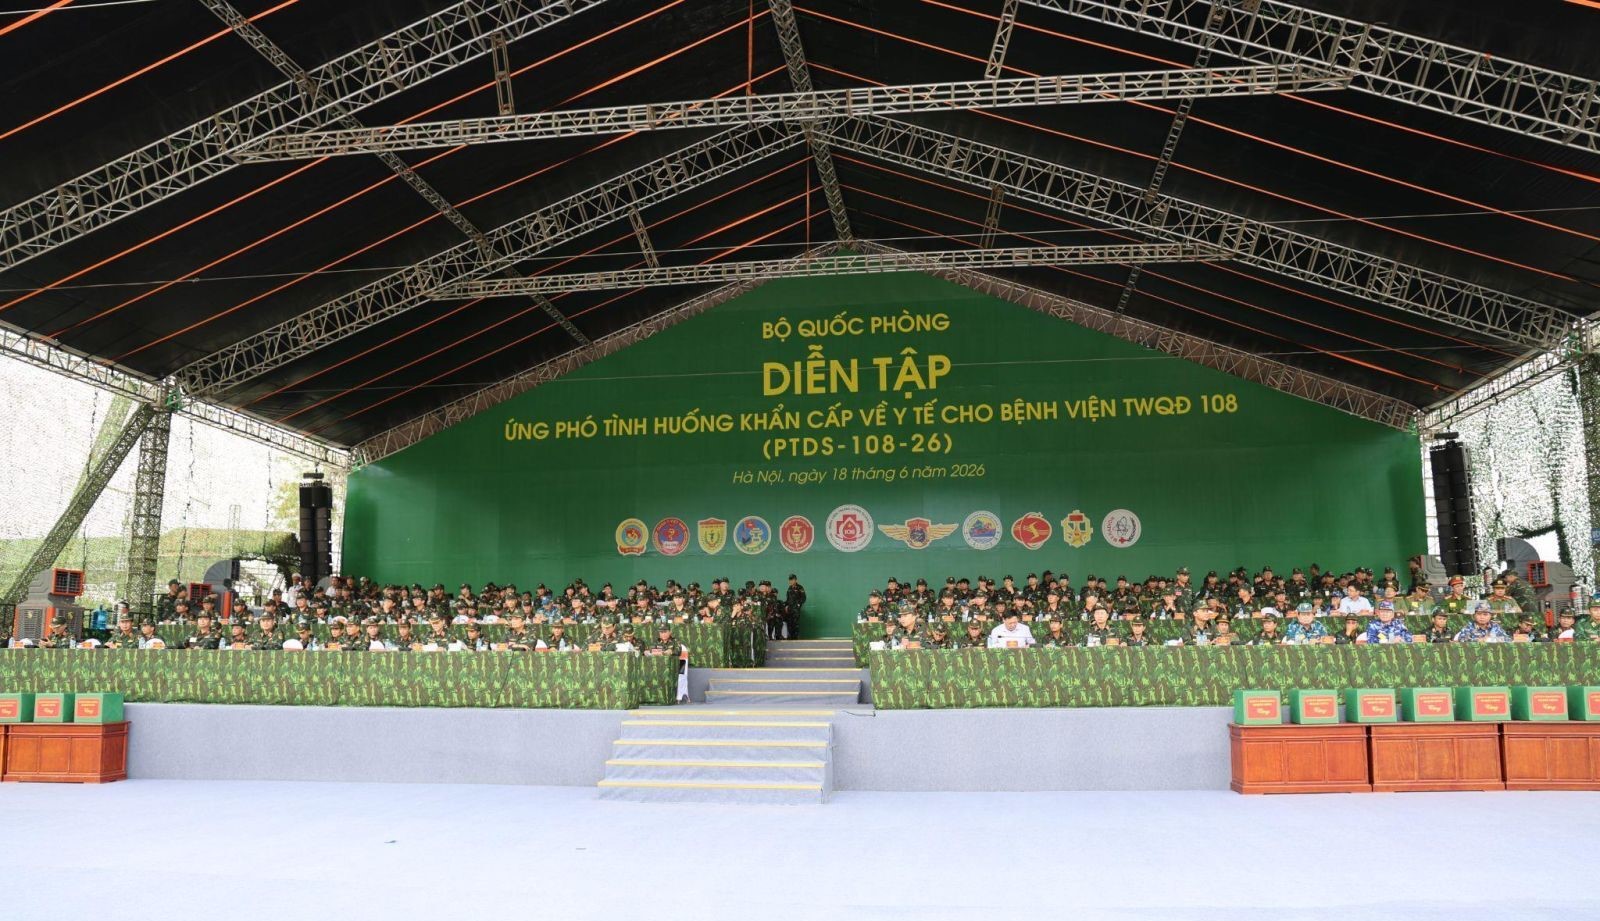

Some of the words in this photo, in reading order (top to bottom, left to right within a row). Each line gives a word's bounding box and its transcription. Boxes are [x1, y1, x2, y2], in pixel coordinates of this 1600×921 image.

[762, 318, 792, 341] BỘ
[797, 311, 864, 338] QUỐC
[870, 311, 950, 335] PHÒNG
[763, 344, 859, 396] DIỄN
[872, 347, 952, 400] TẬP
[505, 417, 549, 442] ỨNG
[555, 416, 598, 438] PHÓ
[603, 414, 648, 437] TÌNH
[654, 408, 734, 434] HUỐNG
[740, 404, 800, 432] KHẨN
[807, 402, 853, 429] CẤP
[860, 400, 887, 427] VỀ
[894, 407, 908, 425] Y
[912, 399, 937, 425] TẾ
[940, 404, 994, 424] CHO
[1000, 398, 1058, 424] BỆNH
[1065, 396, 1117, 422] VIỆN
[1122, 395, 1192, 417] TWQĐ
[1201, 393, 1238, 414] 108
[762, 433, 953, 460] (PTDS-108-26)
[732, 469, 753, 484] Hà
[757, 468, 784, 486] Nội,
[788, 468, 826, 485] ngày
[832, 467, 848, 481] 18
[852, 465, 896, 483] tháng
[899, 465, 909, 479] 6
[912, 464, 946, 479] năm
[950, 463, 986, 478] 2026
